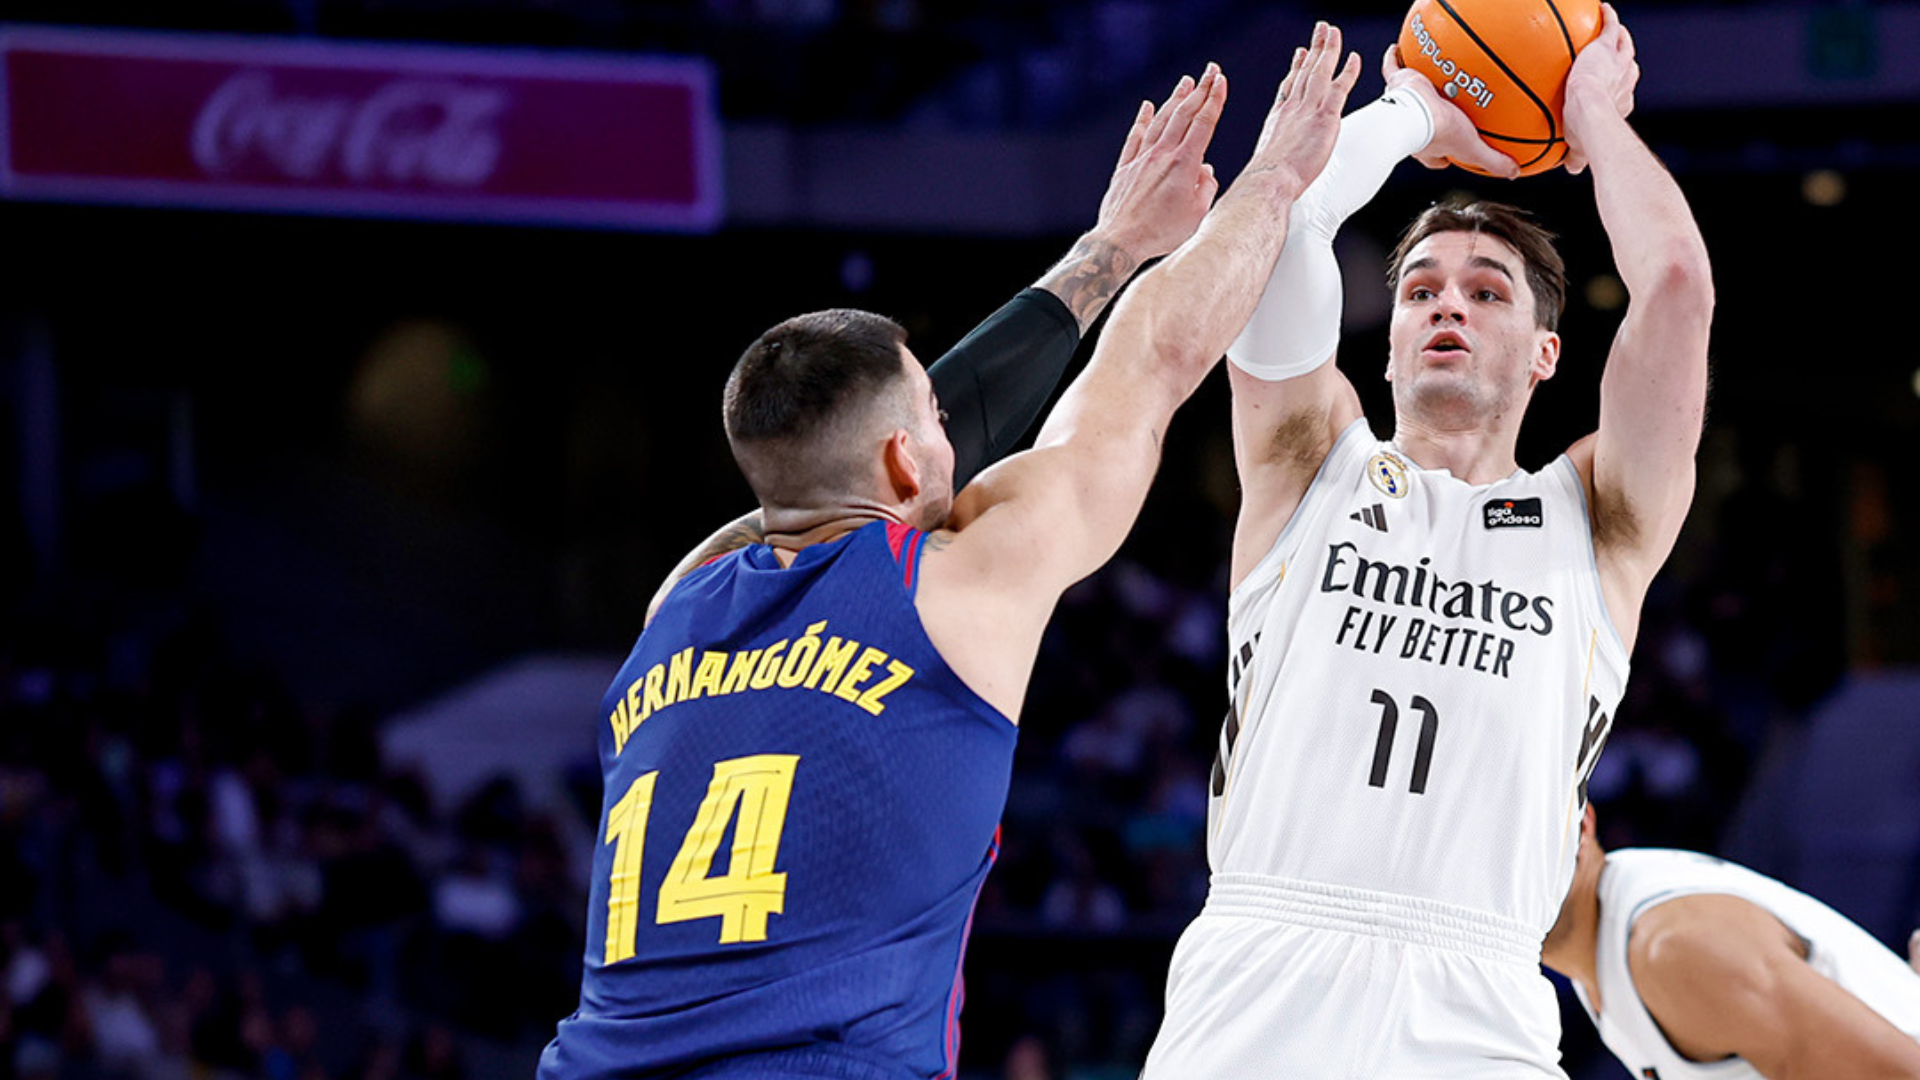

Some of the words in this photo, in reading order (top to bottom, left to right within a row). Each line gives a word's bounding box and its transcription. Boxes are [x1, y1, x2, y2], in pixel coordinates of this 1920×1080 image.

[1410, 12, 1456, 76] endesa
[1453, 69, 1494, 109] liga
[1321, 541, 1554, 636] Emirates
[609, 619, 915, 757] HERNANGÓMEZ
[1335, 605, 1397, 654] FLY
[1400, 617, 1515, 678] BETTER
[1368, 688, 1439, 794] 11
[604, 754, 801, 967] 14
